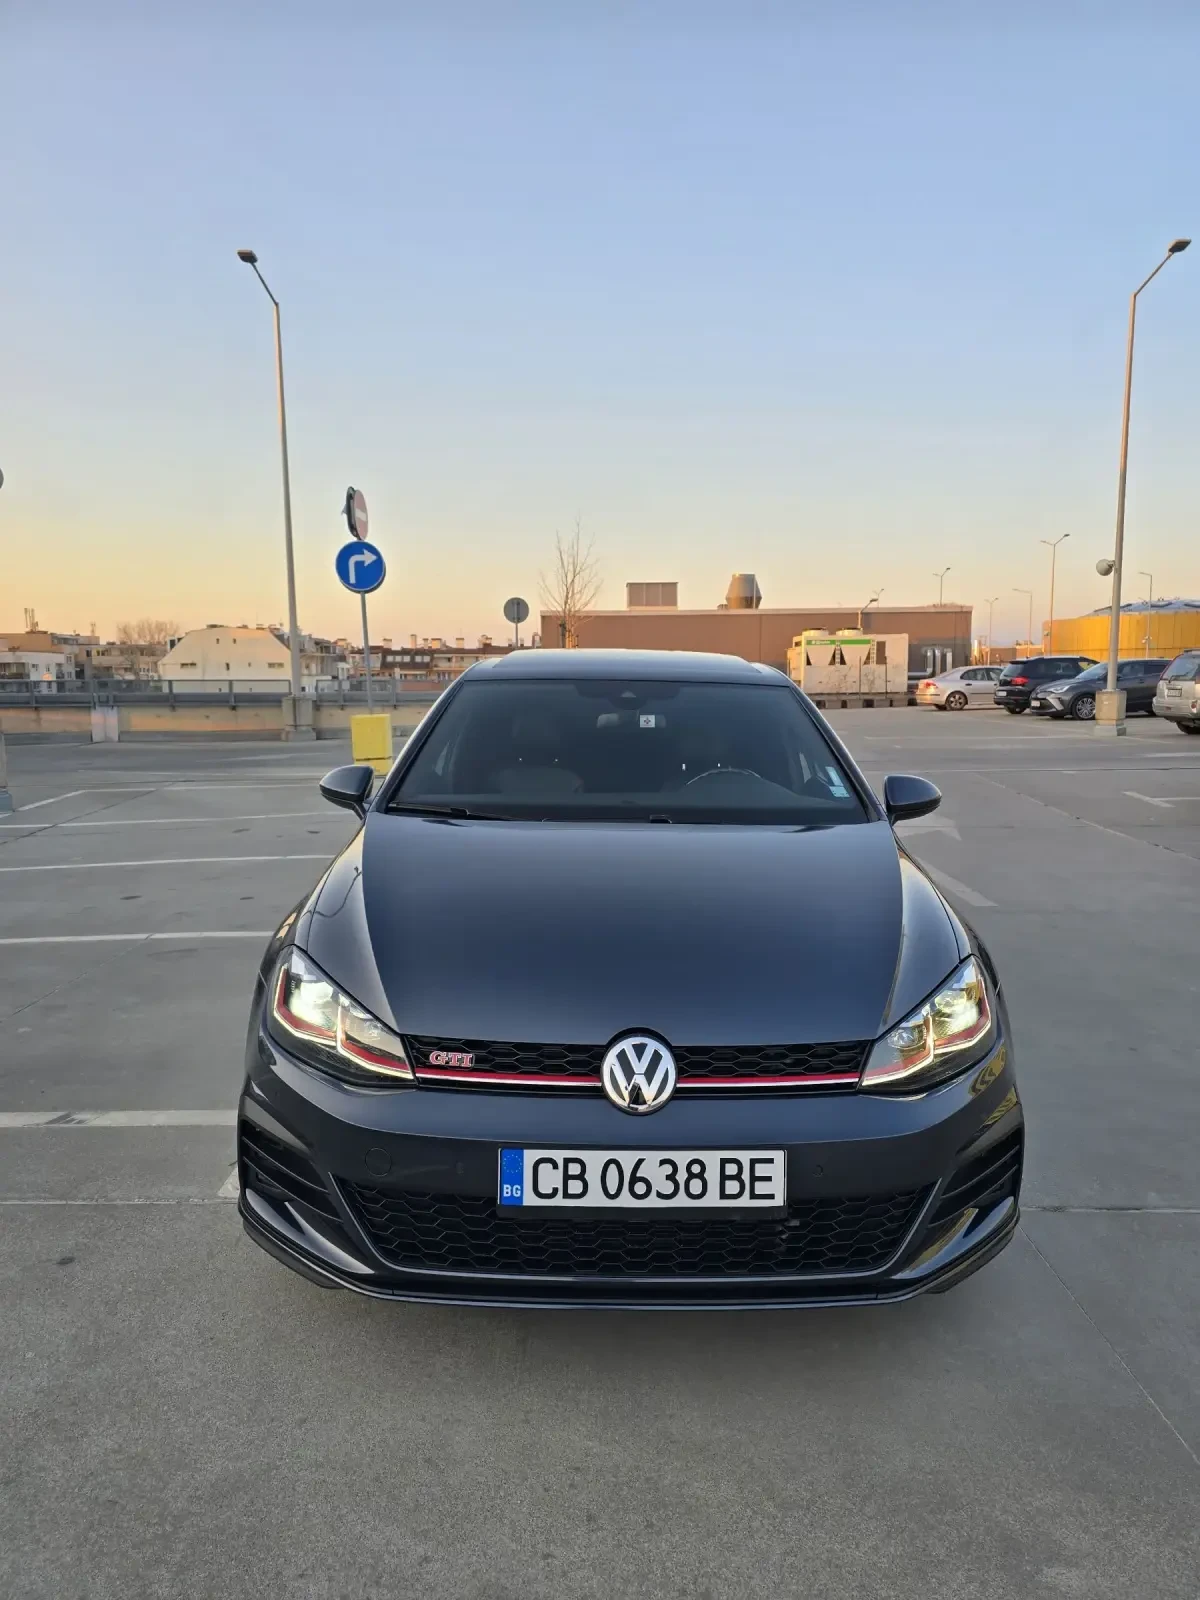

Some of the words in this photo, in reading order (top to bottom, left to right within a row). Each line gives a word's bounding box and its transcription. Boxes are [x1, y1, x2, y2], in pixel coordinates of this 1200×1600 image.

[429, 1050, 474, 1068] GTI
[605, 1038, 674, 1110] VW
[503, 1184, 521, 1197] BG
[532, 1156, 589, 1200] CB
[600, 1157, 708, 1201] 0638
[719, 1157, 776, 1200] BE
